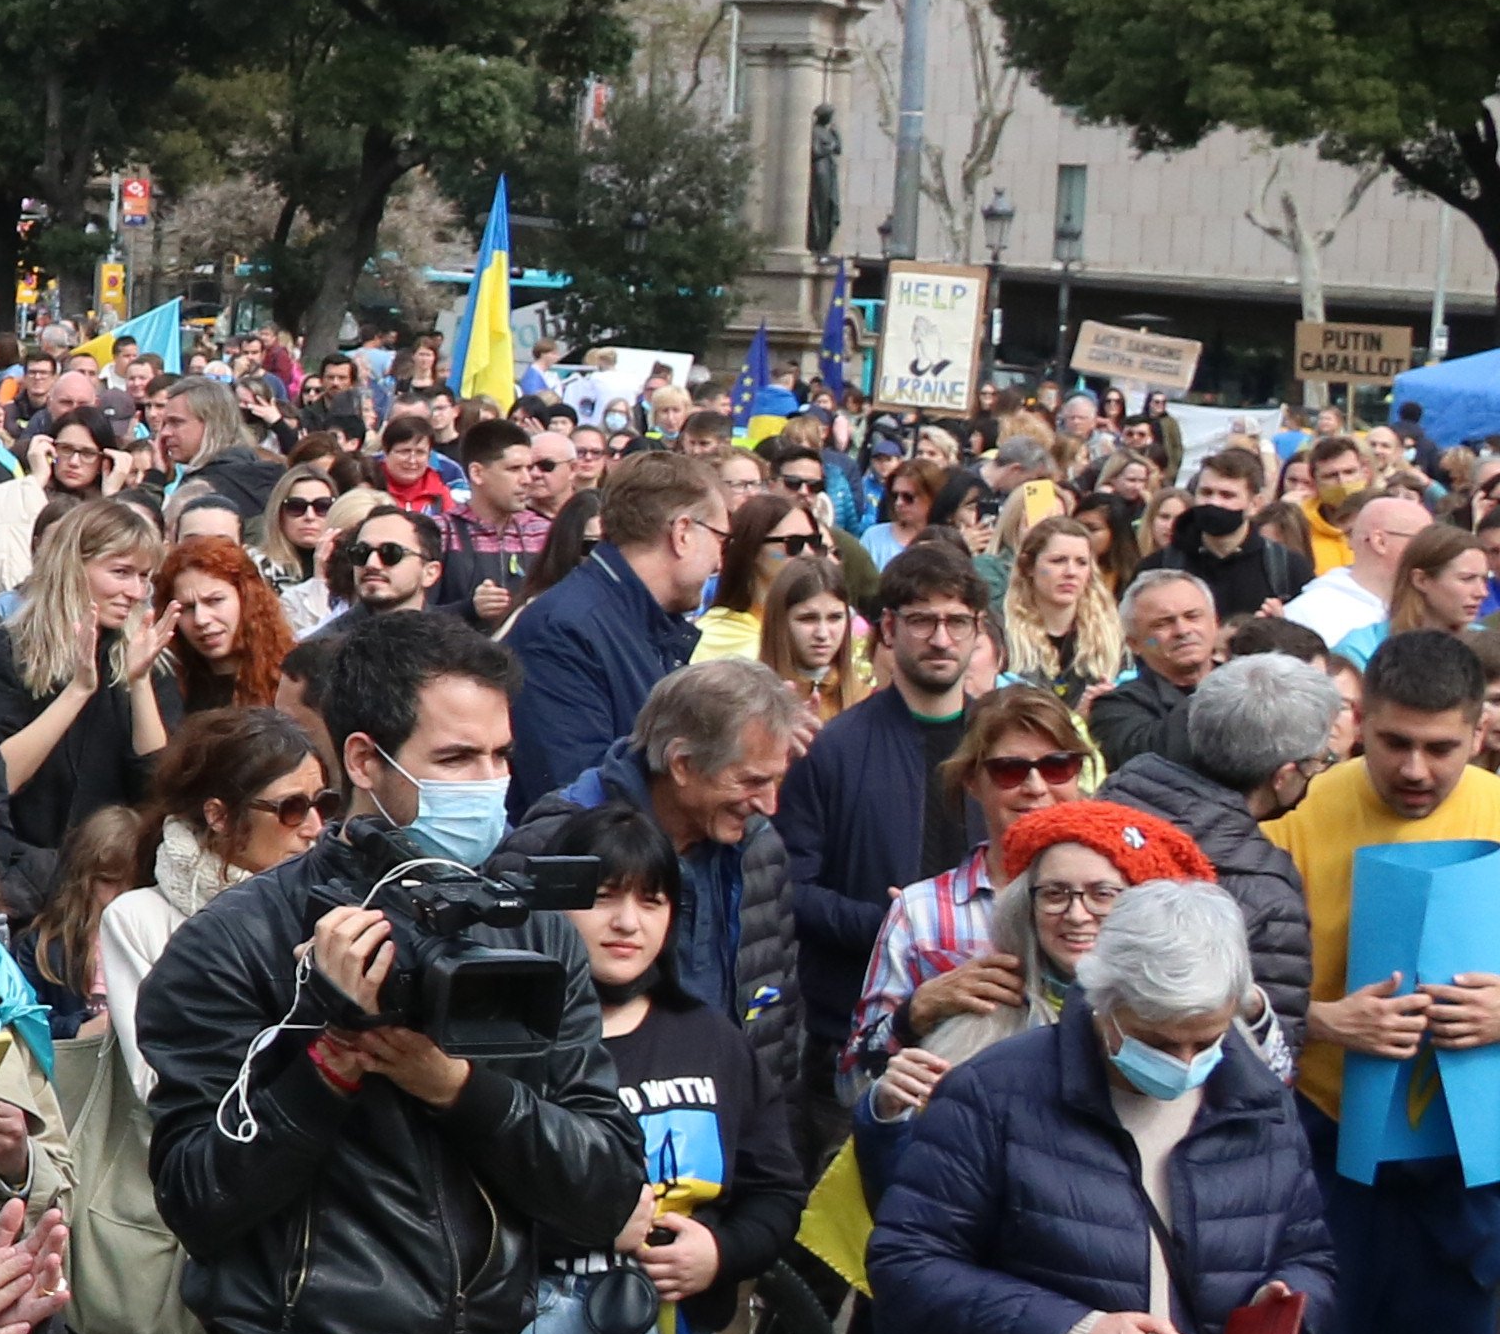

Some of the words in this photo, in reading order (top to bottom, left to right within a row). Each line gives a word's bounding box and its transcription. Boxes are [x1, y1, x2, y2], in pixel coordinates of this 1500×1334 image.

[899, 280, 967, 310] HELP
[1322, 330, 1382, 352] PUTIN
[1301, 351, 1406, 377] CARALLOT
[879, 375, 967, 406] UKRAINE
[640, 1076, 717, 1107] WITH
